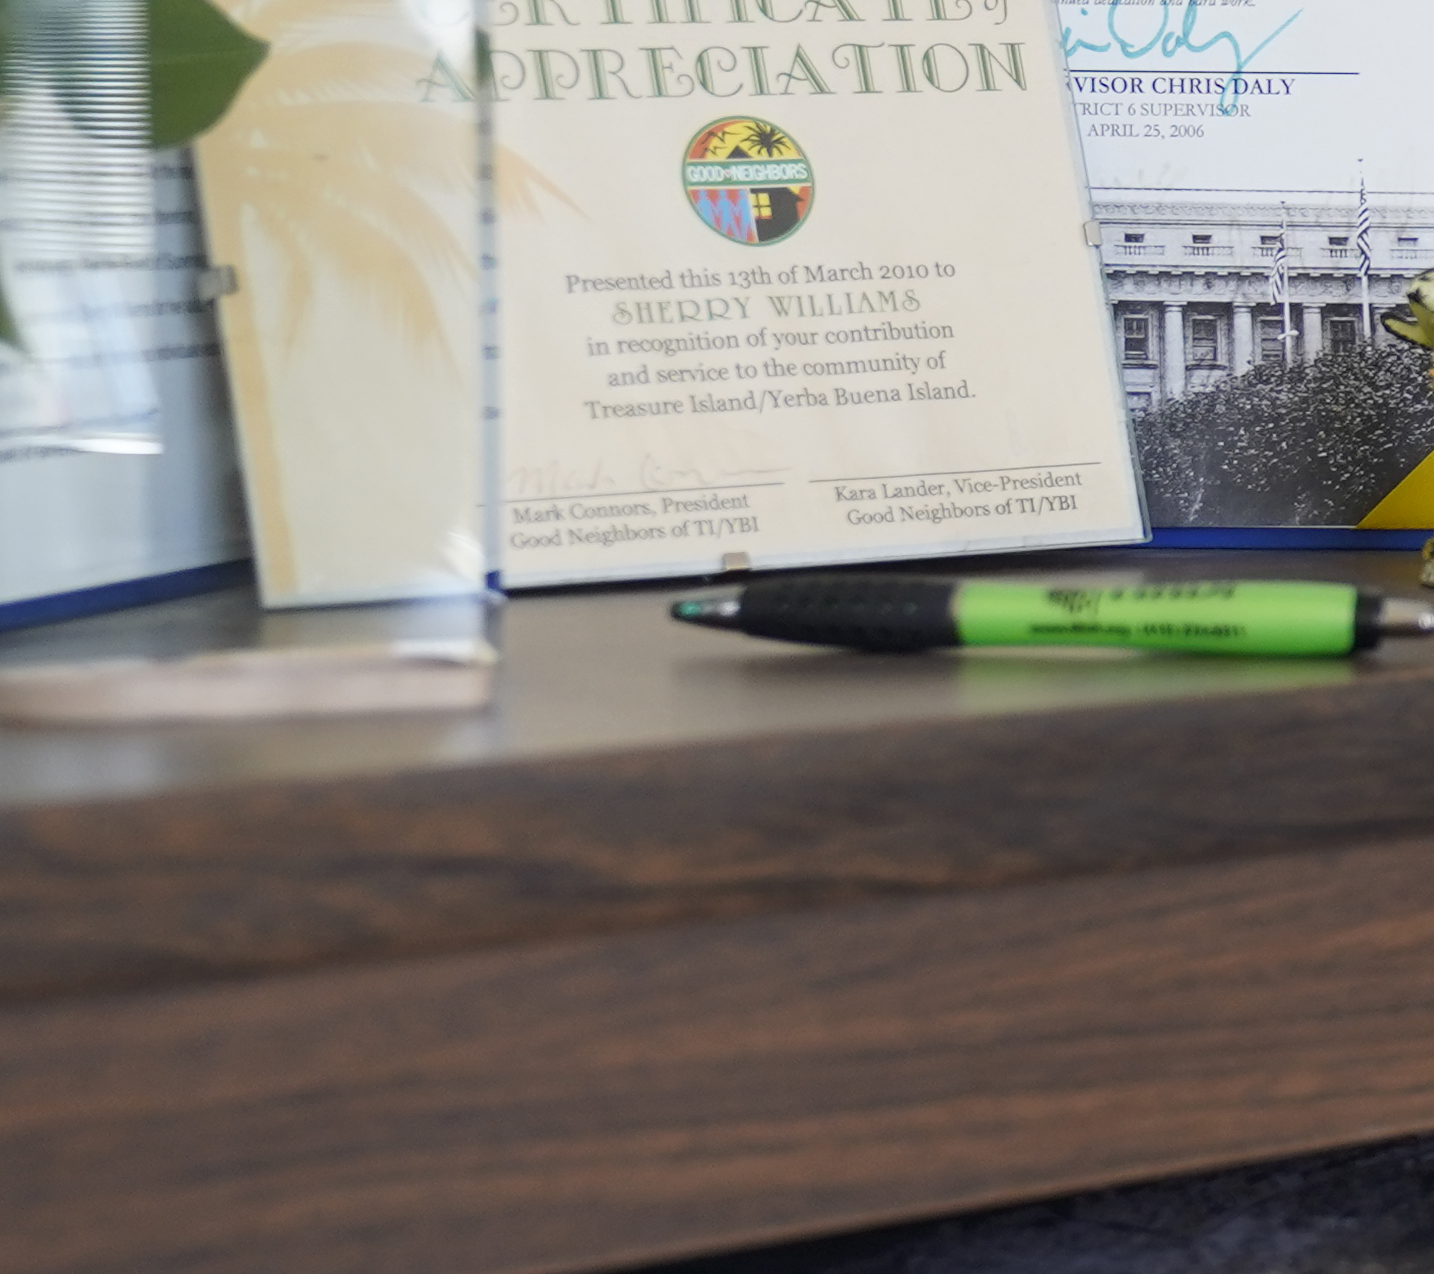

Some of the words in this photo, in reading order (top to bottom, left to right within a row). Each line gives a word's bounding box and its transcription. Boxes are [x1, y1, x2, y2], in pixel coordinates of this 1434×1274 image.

[416, 40, 1027, 104] APPRECIATION
[1152, 77, 1226, 95] CHRIS
[1232, 78, 1295, 95] DALY
[1140, 103, 1251, 117] SUPERVISOR
[1087, 123, 1138, 137] APRIL
[1143, 124, 1164, 139] 25,
[1169, 125, 1204, 137] 2006
[687, 165, 724, 182] GOOD
[731, 162, 807, 181] NEIGHBORS
[565, 270, 674, 293] Presented
[679, 268, 721, 287] this
[728, 266, 772, 288] 13th
[777, 264, 797, 284] of
[803, 261, 873, 283] March
[879, 264, 928, 279] 2010
[934, 261, 955, 277] to
[612, 297, 749, 324] SHERRY
[767, 289, 920, 316] WILLIAMS
[587, 337, 609, 355] in
[616, 331, 740, 355] recognition
[745, 326, 766, 347] of
[772, 332, 818, 350] your
[824, 320, 954, 344] contribution
[608, 364, 650, 386] and
[656, 362, 729, 382] service
[735, 363, 757, 378] to
[762, 357, 797, 376] the
[802, 352, 919, 375] community
[926, 350, 946, 369] of
[584, 400, 683, 418] Treasure
[688, 387, 829, 413] Island/Yerba
[833, 387, 901, 405] Buena
[906, 379, 975, 400] Island.
[834, 485, 876, 501] Kara
[881, 479, 950, 498] Lander,
[953, 471, 1082, 493] Vice-President
[512, 503, 565, 523] Mark
[568, 502, 656, 519] Connors,
[660, 493, 750, 513] President
[846, 506, 894, 524] Good
[899, 502, 990, 523] Neighbors
[1015, 494, 1077, 515] TI/YBI
[509, 529, 562, 548] Good
[567, 523, 666, 544] Neighbors
[692, 516, 759, 537] TI/YBI
